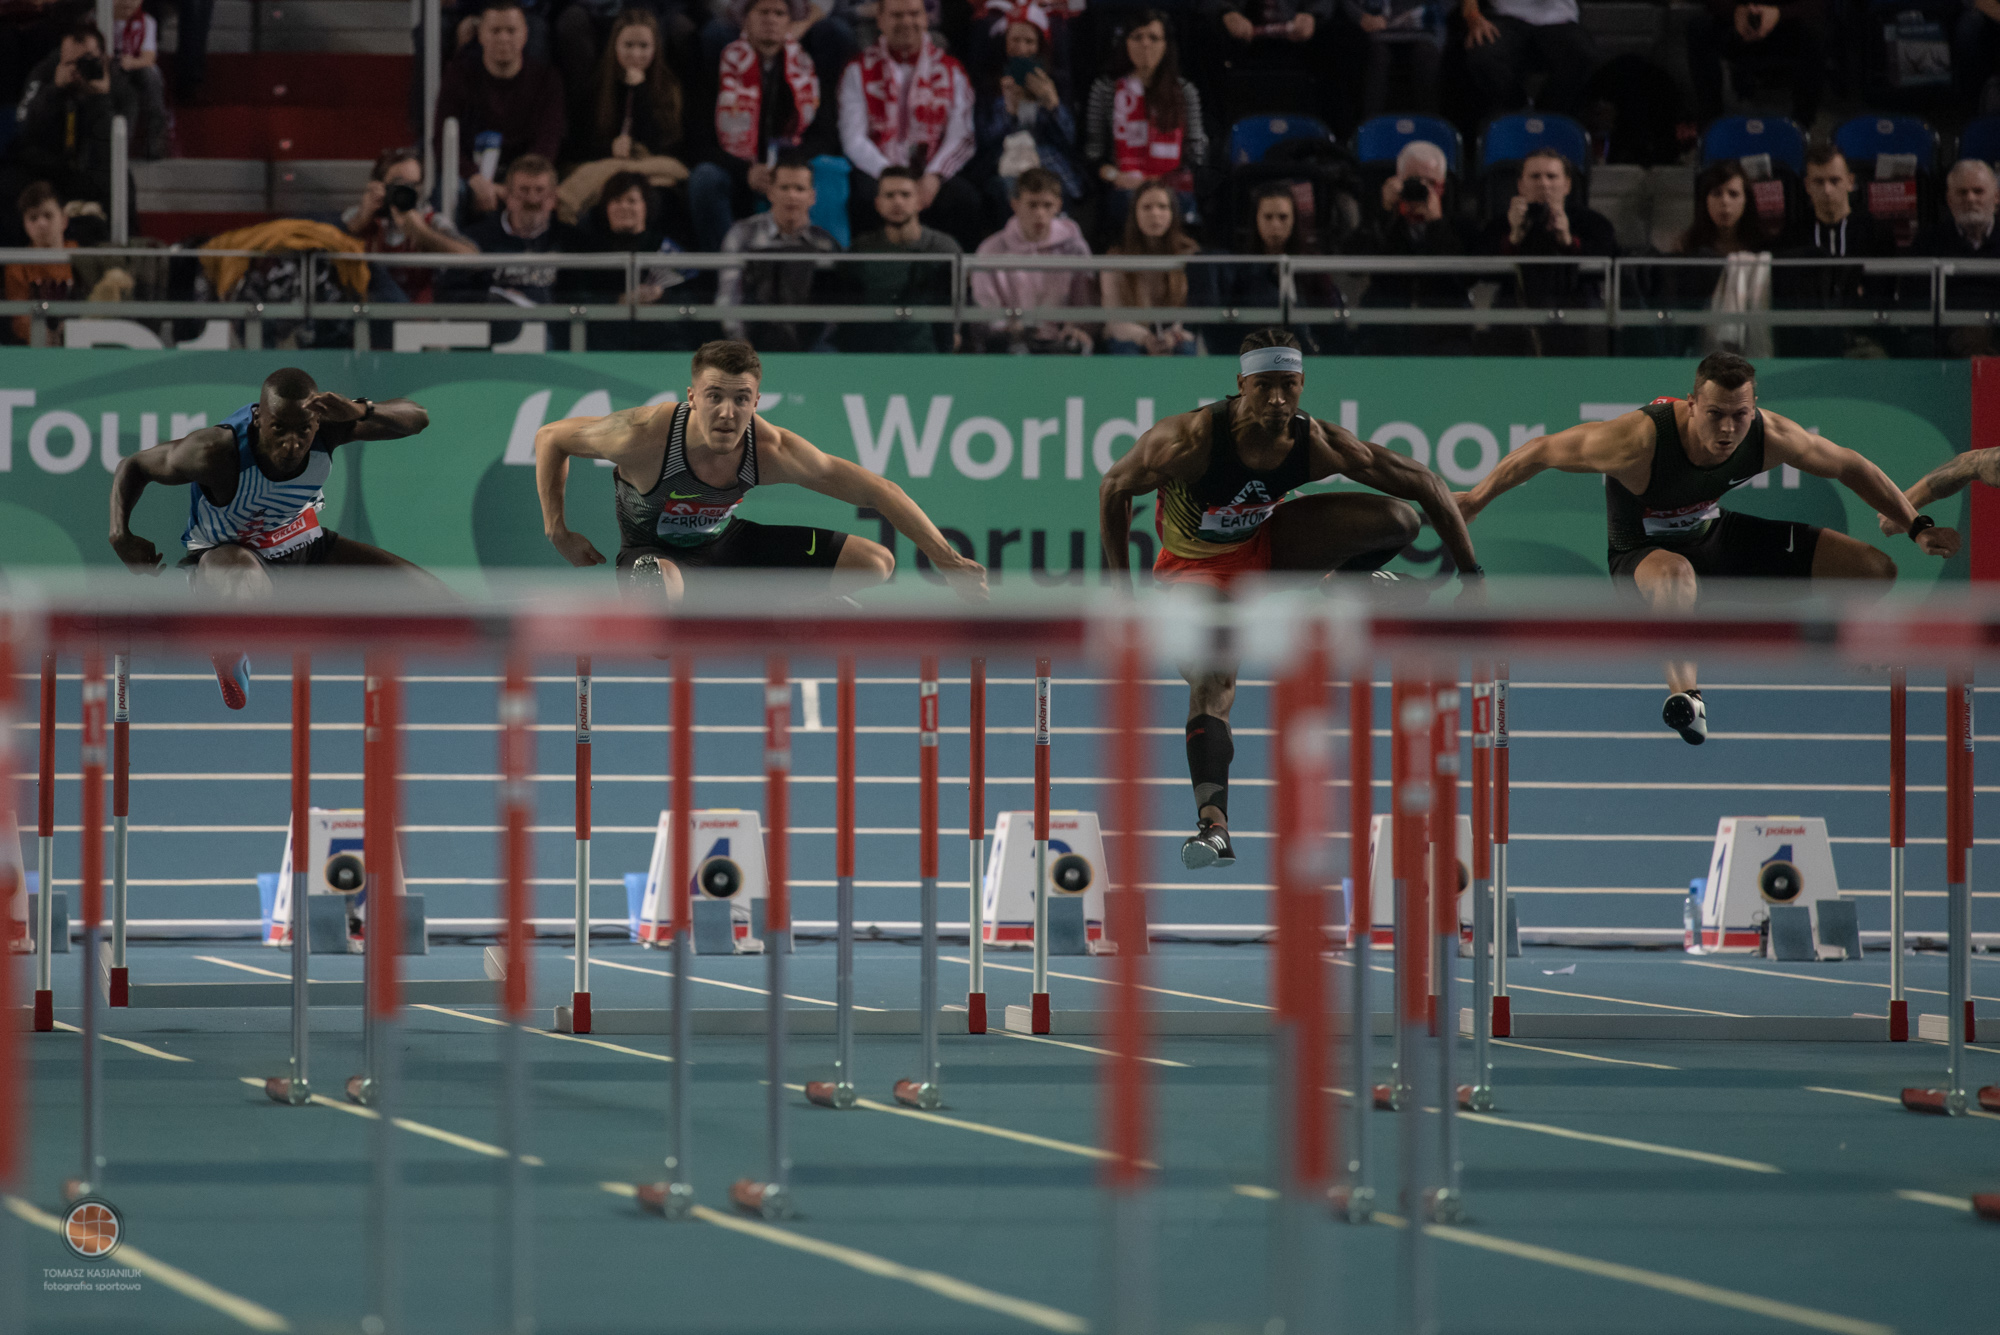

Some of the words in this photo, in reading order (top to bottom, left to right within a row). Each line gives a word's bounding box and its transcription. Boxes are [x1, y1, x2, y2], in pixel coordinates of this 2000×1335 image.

[842, 394, 1155, 480] World
[1221, 511, 1268, 528] EATON
[117, 673, 127, 710] polanik
[579, 693, 589, 731] polanik
[1038, 695, 1048, 732] polanik
[1496, 698, 1507, 735] polanik
[1765, 826, 1806, 837] polanik
